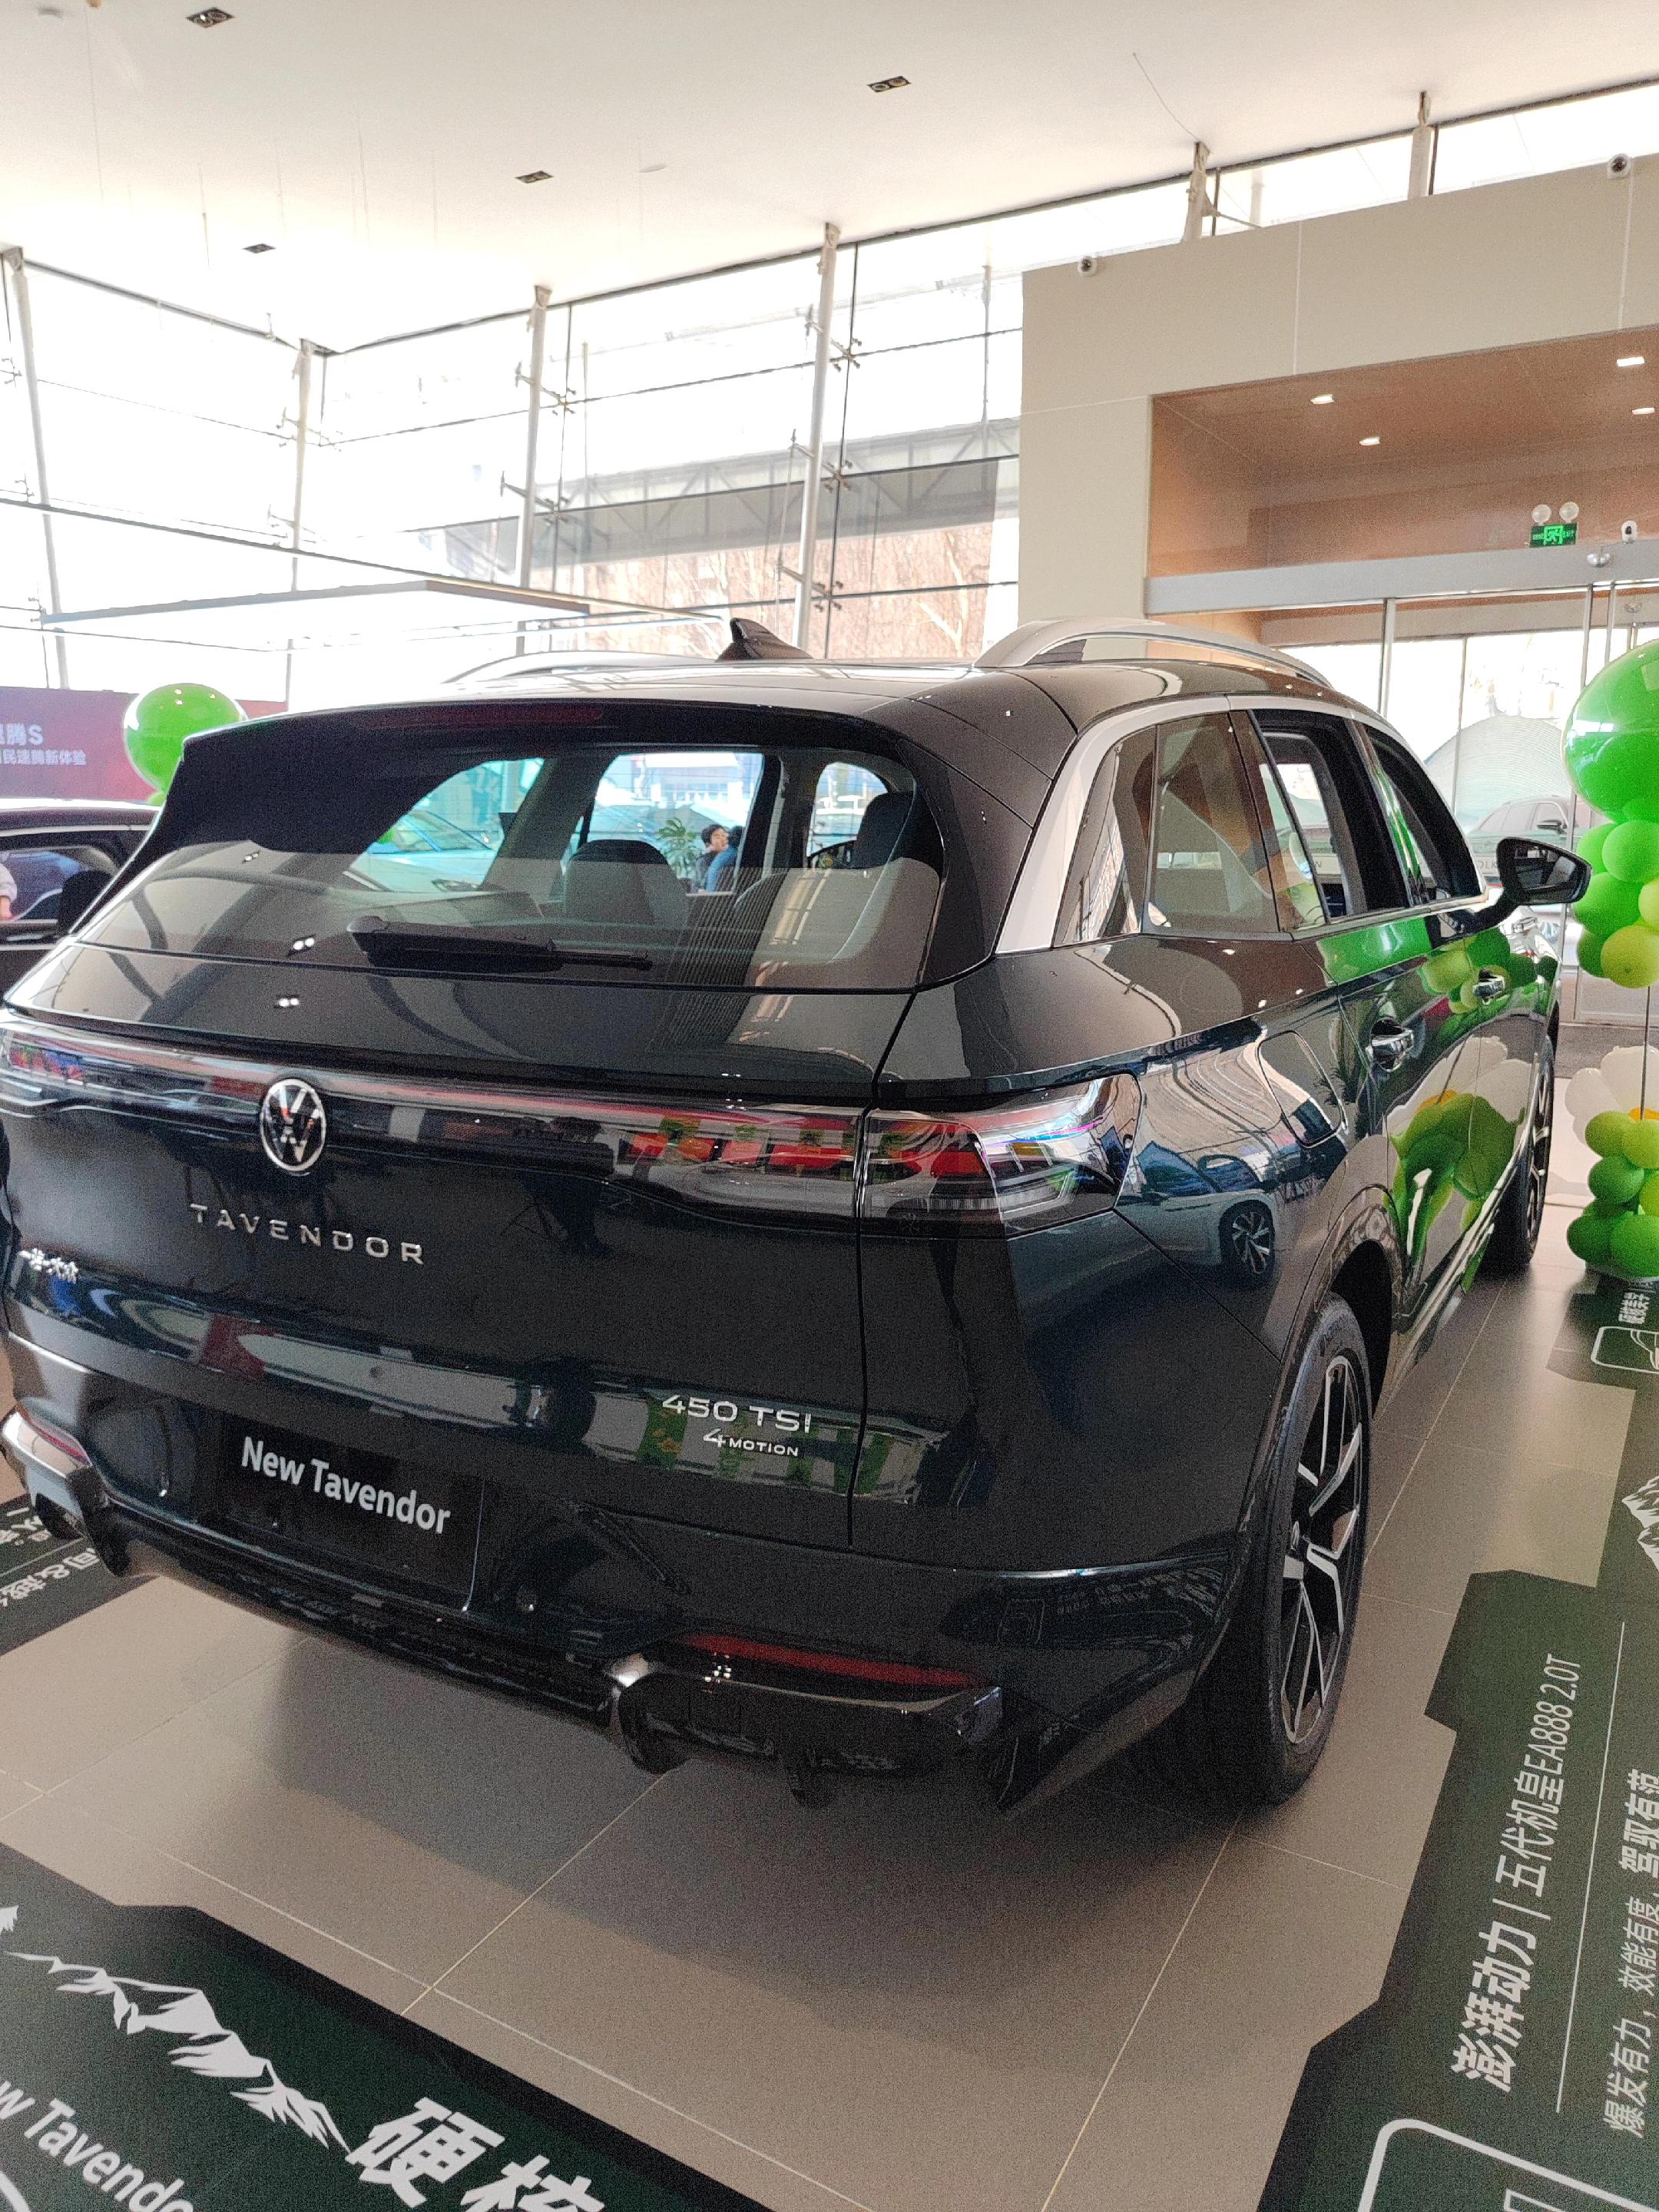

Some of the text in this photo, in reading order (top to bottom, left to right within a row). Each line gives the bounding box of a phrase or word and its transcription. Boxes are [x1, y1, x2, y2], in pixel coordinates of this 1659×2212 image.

[0, 723, 44, 747] 腾S
[0, 749, 87, 766] 民速腾新体验
[190, 1204, 423, 1265] TAVENDOR
[662, 1394, 812, 1433] 450 TSI
[241, 1436, 452, 1535] New Tavendor
[1451, 1921, 1537, 2093] 澎湃动力
[1539, 1653, 1581, 1701] 2.0T
